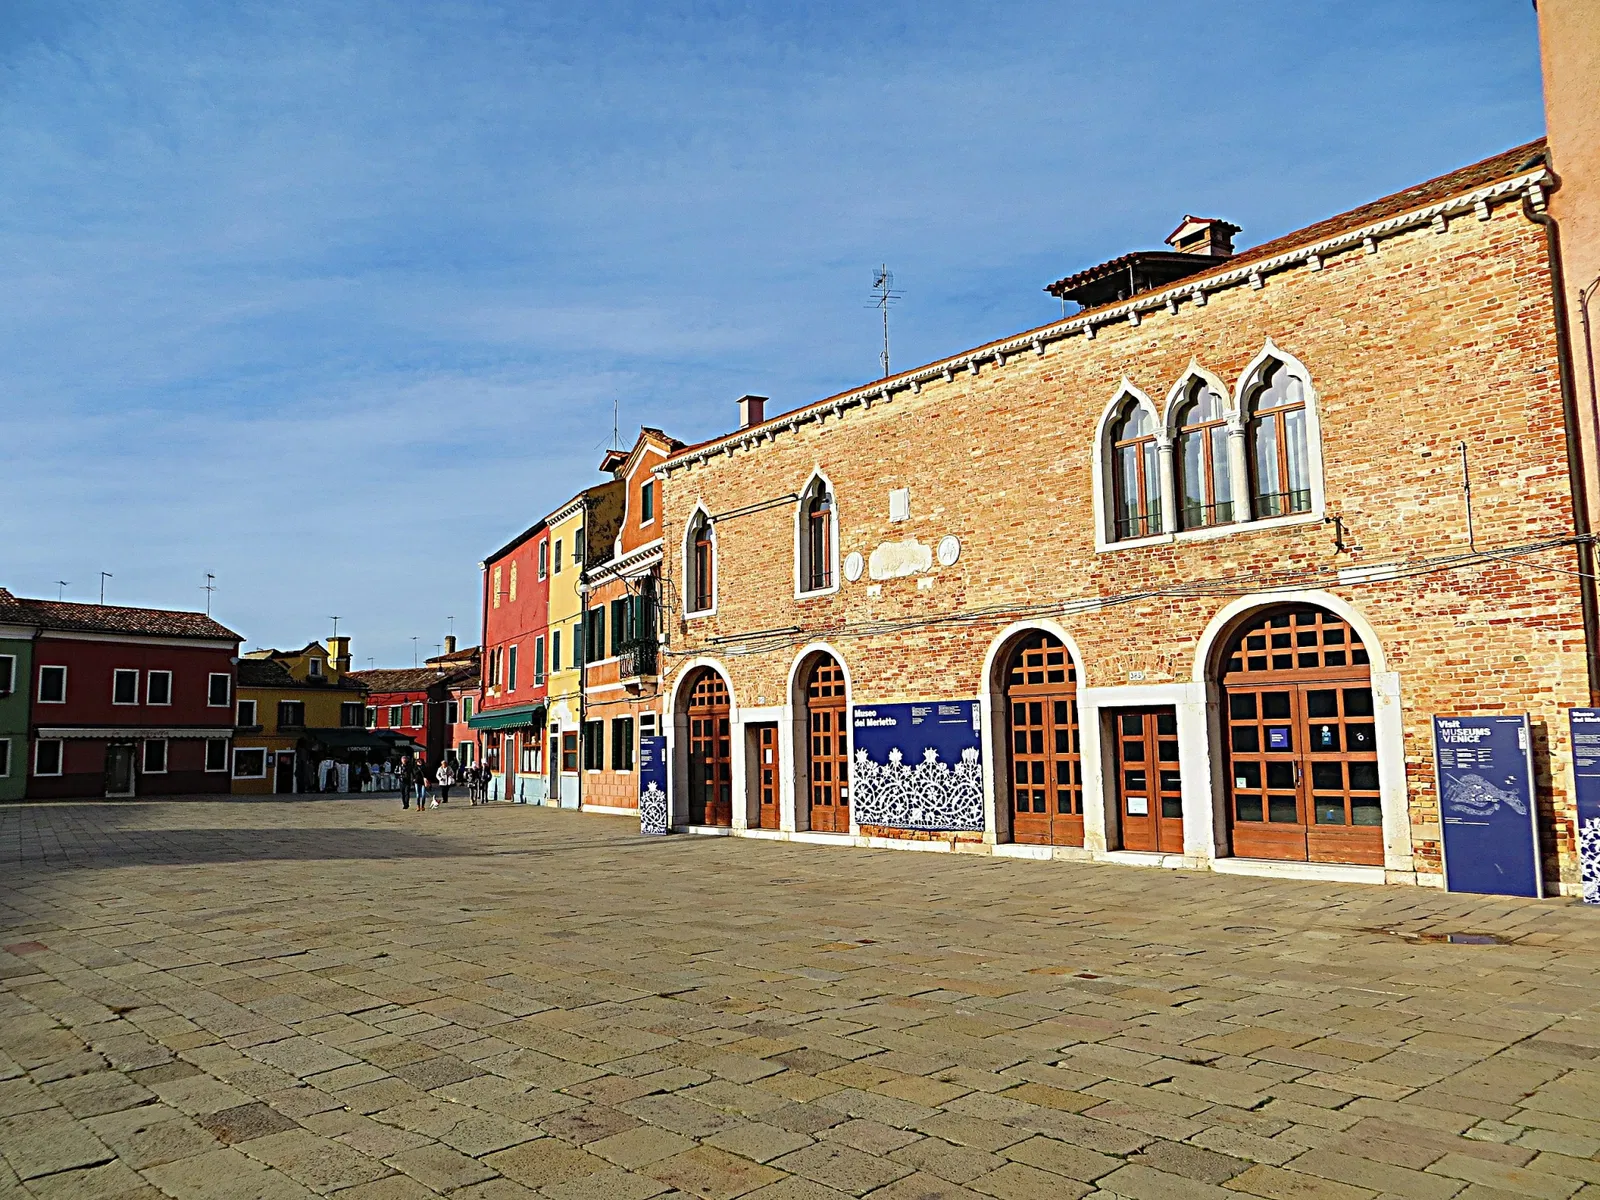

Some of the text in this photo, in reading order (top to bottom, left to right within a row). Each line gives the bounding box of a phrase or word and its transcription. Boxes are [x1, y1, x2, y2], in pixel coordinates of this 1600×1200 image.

[854, 709, 877, 718] Museo
[854, 717, 897, 727] del Merletto
[1437, 720, 1461, 728] Visit
[1442, 728, 1492, 736] MUSEUMS
[1443, 735, 1481, 743] VENICE
